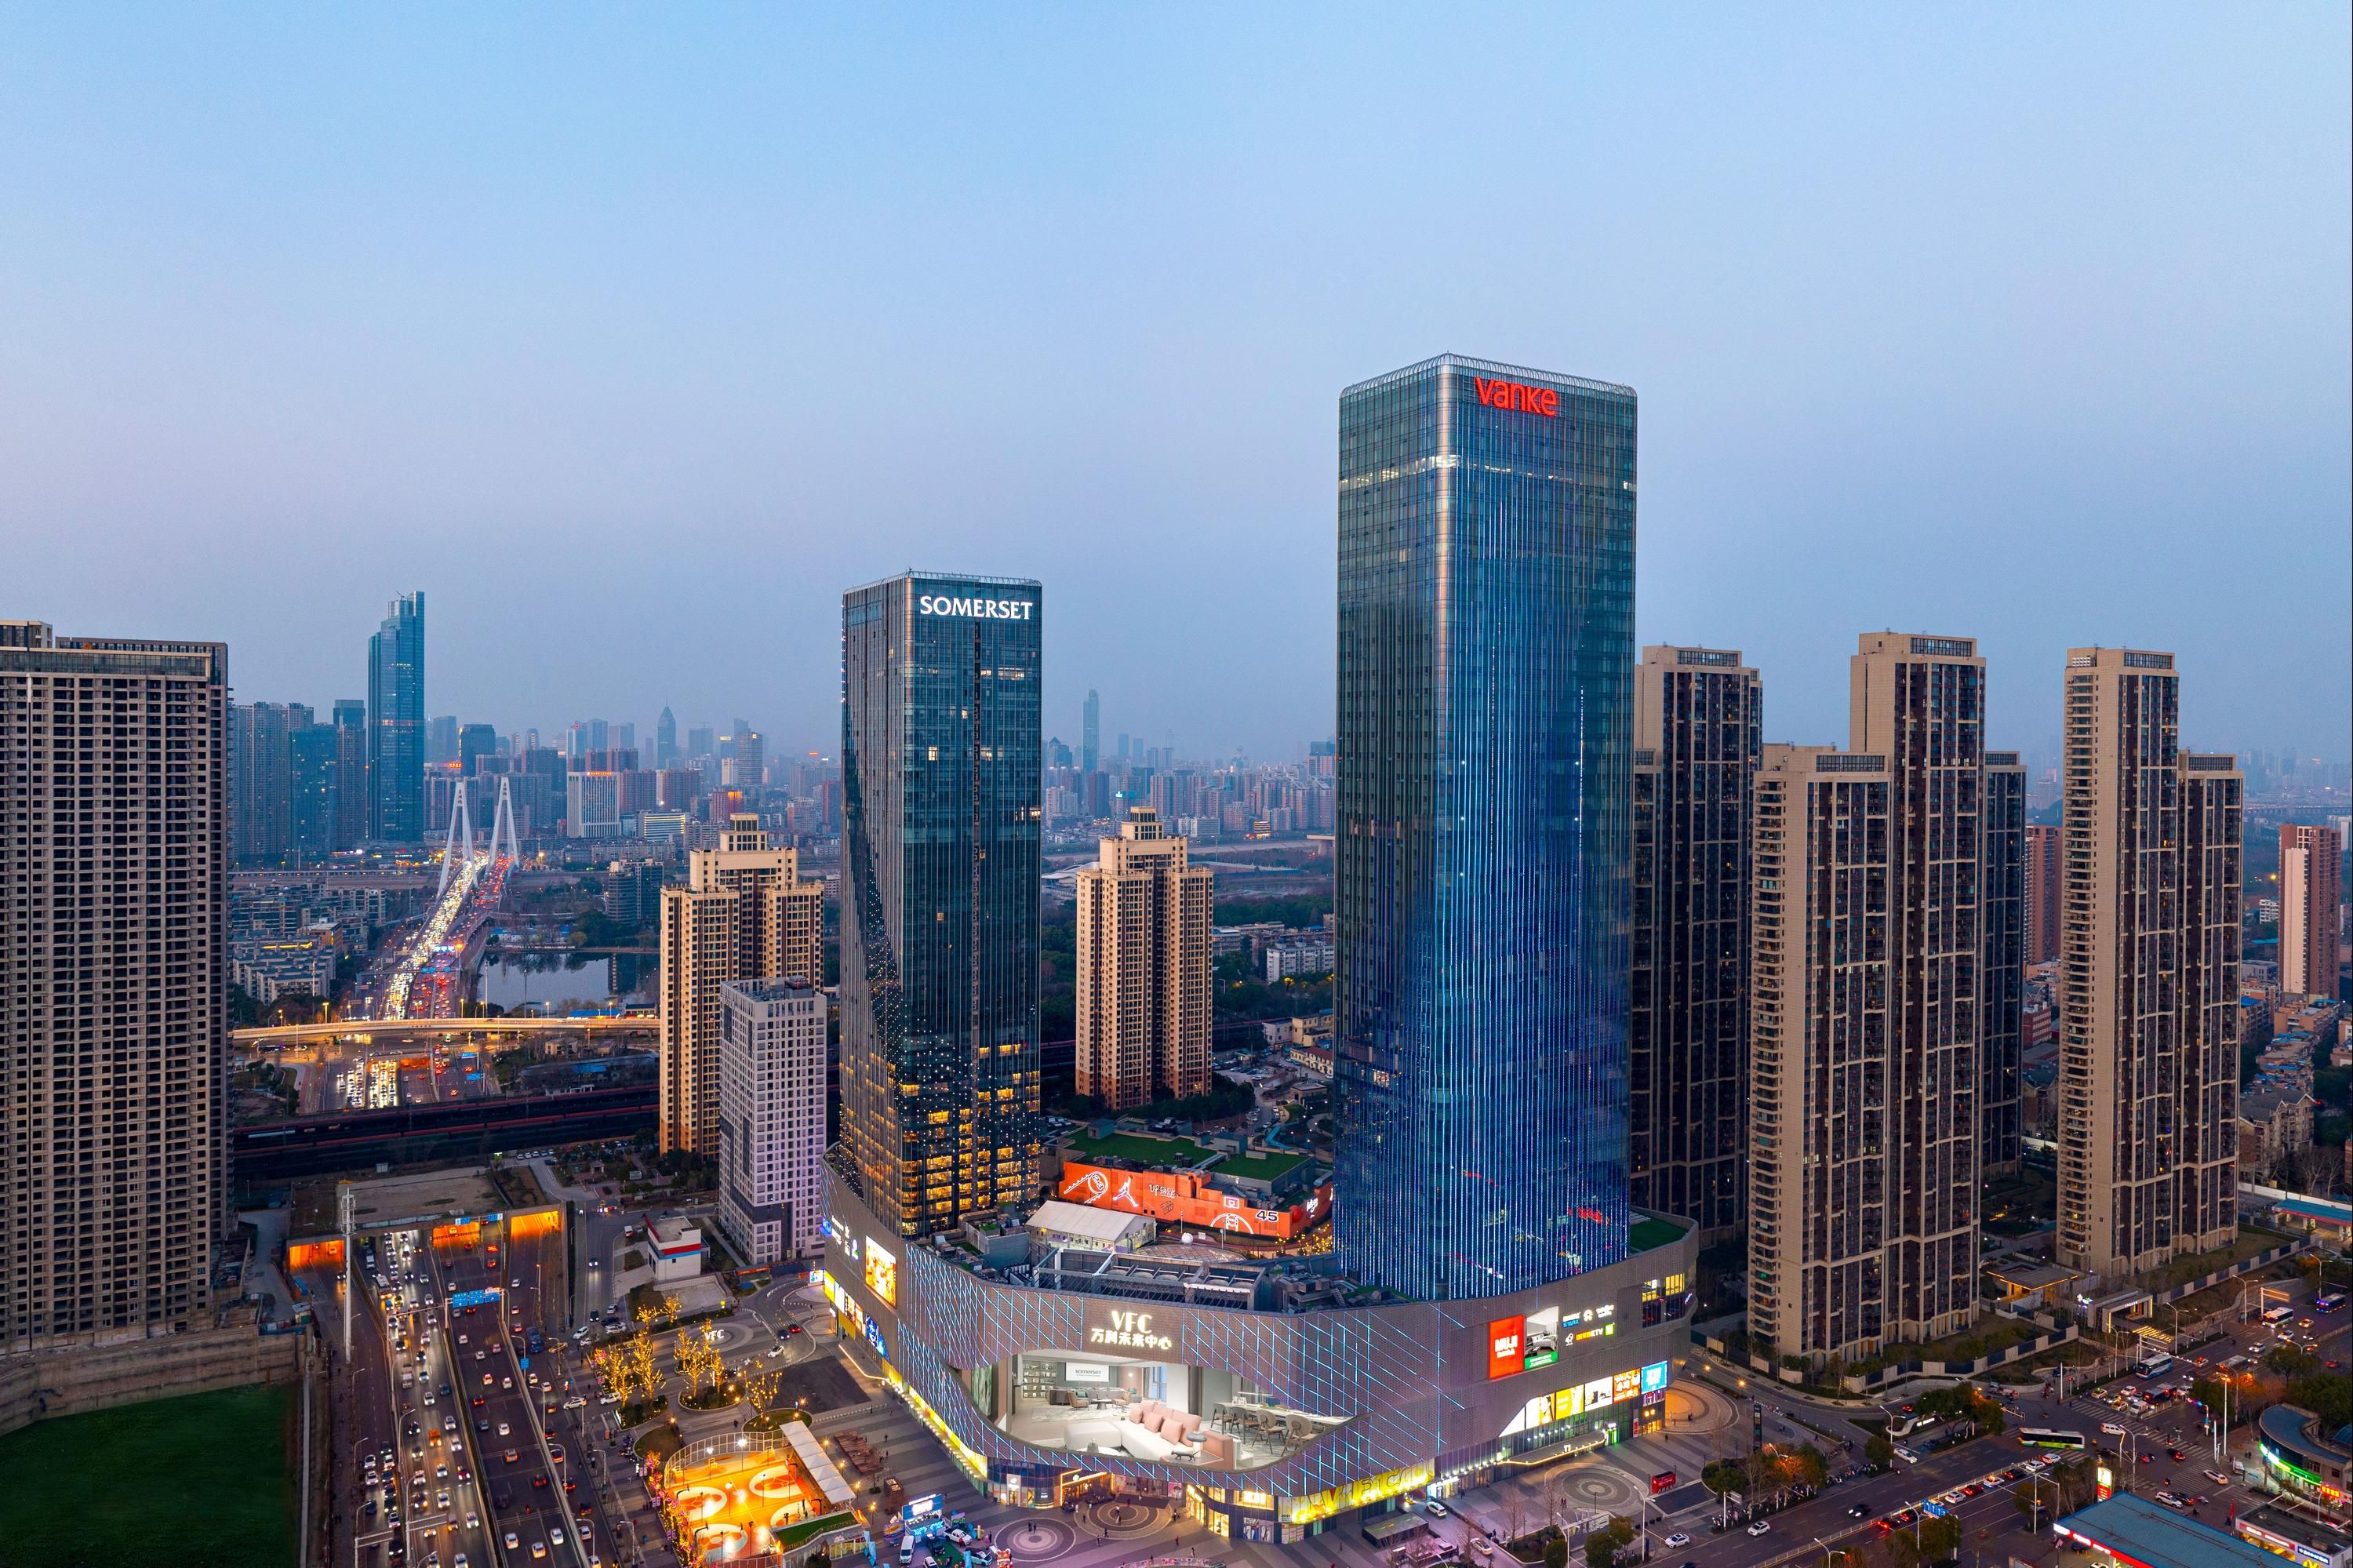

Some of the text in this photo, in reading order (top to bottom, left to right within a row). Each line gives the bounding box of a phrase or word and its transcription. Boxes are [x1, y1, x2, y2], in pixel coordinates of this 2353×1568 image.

[920, 596, 1033, 620] SOMERSET
[1256, 1210, 1278, 1222] 45
[1111, 1311, 1153, 1333] VFC
[704, 1329, 725, 1341] VFC
[1090, 1328, 1173, 1349] 万科未来中心
